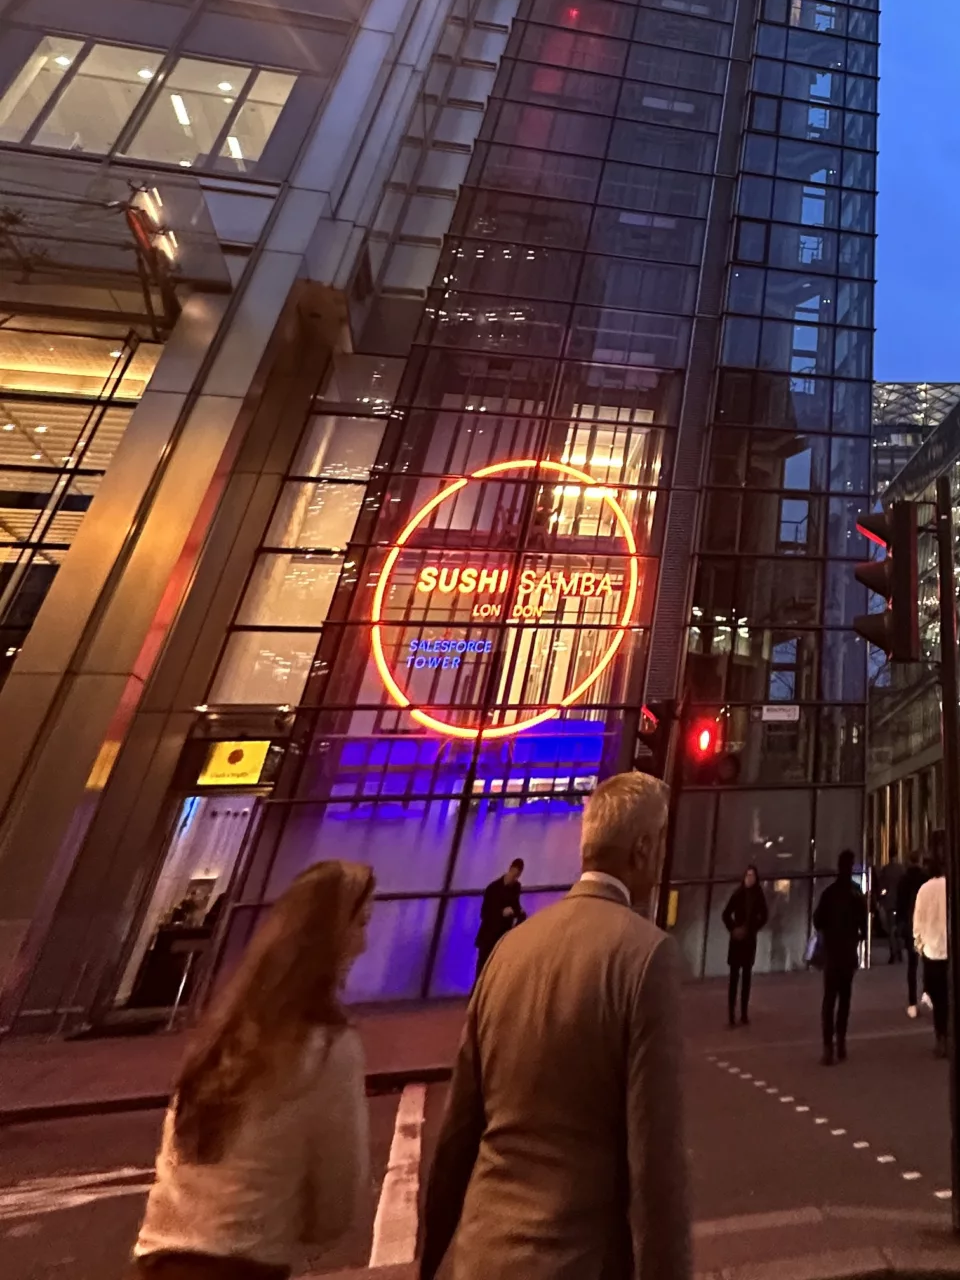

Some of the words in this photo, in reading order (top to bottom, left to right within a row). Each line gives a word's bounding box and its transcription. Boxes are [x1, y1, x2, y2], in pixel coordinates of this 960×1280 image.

[417, 567, 508, 593] SUSHI
[519, 570, 613, 596] SAMBA
[409, 640, 492, 653] SALESFORCE
[406, 656, 461, 669] TOWER
